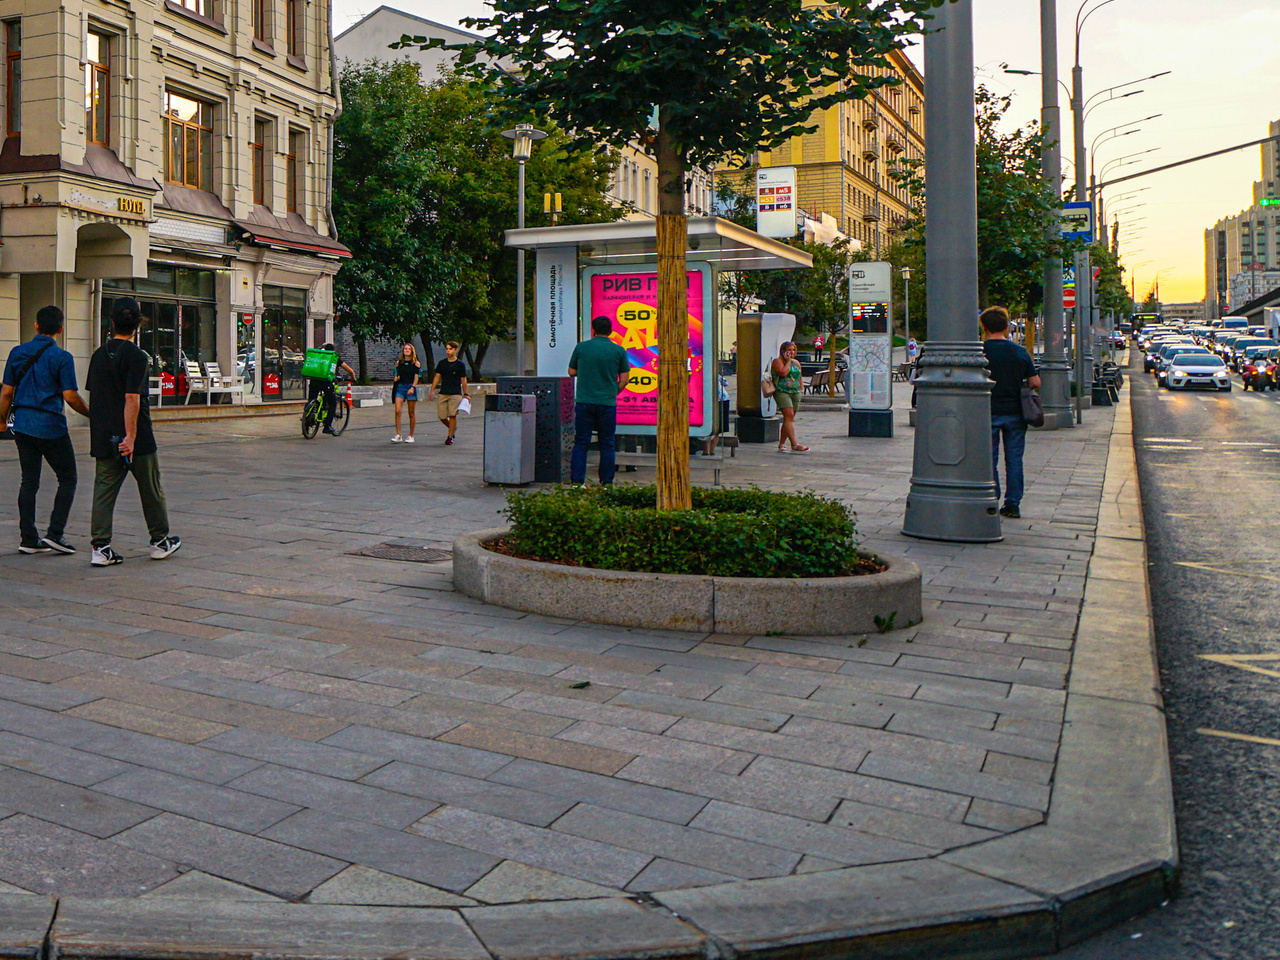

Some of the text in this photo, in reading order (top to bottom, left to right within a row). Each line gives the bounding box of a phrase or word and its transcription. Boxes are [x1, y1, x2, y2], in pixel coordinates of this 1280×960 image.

[120, 198, 146, 214] HOTEL
[603, 277, 642, 292] РИВ
[549, 301, 557, 349] Самотёчная
